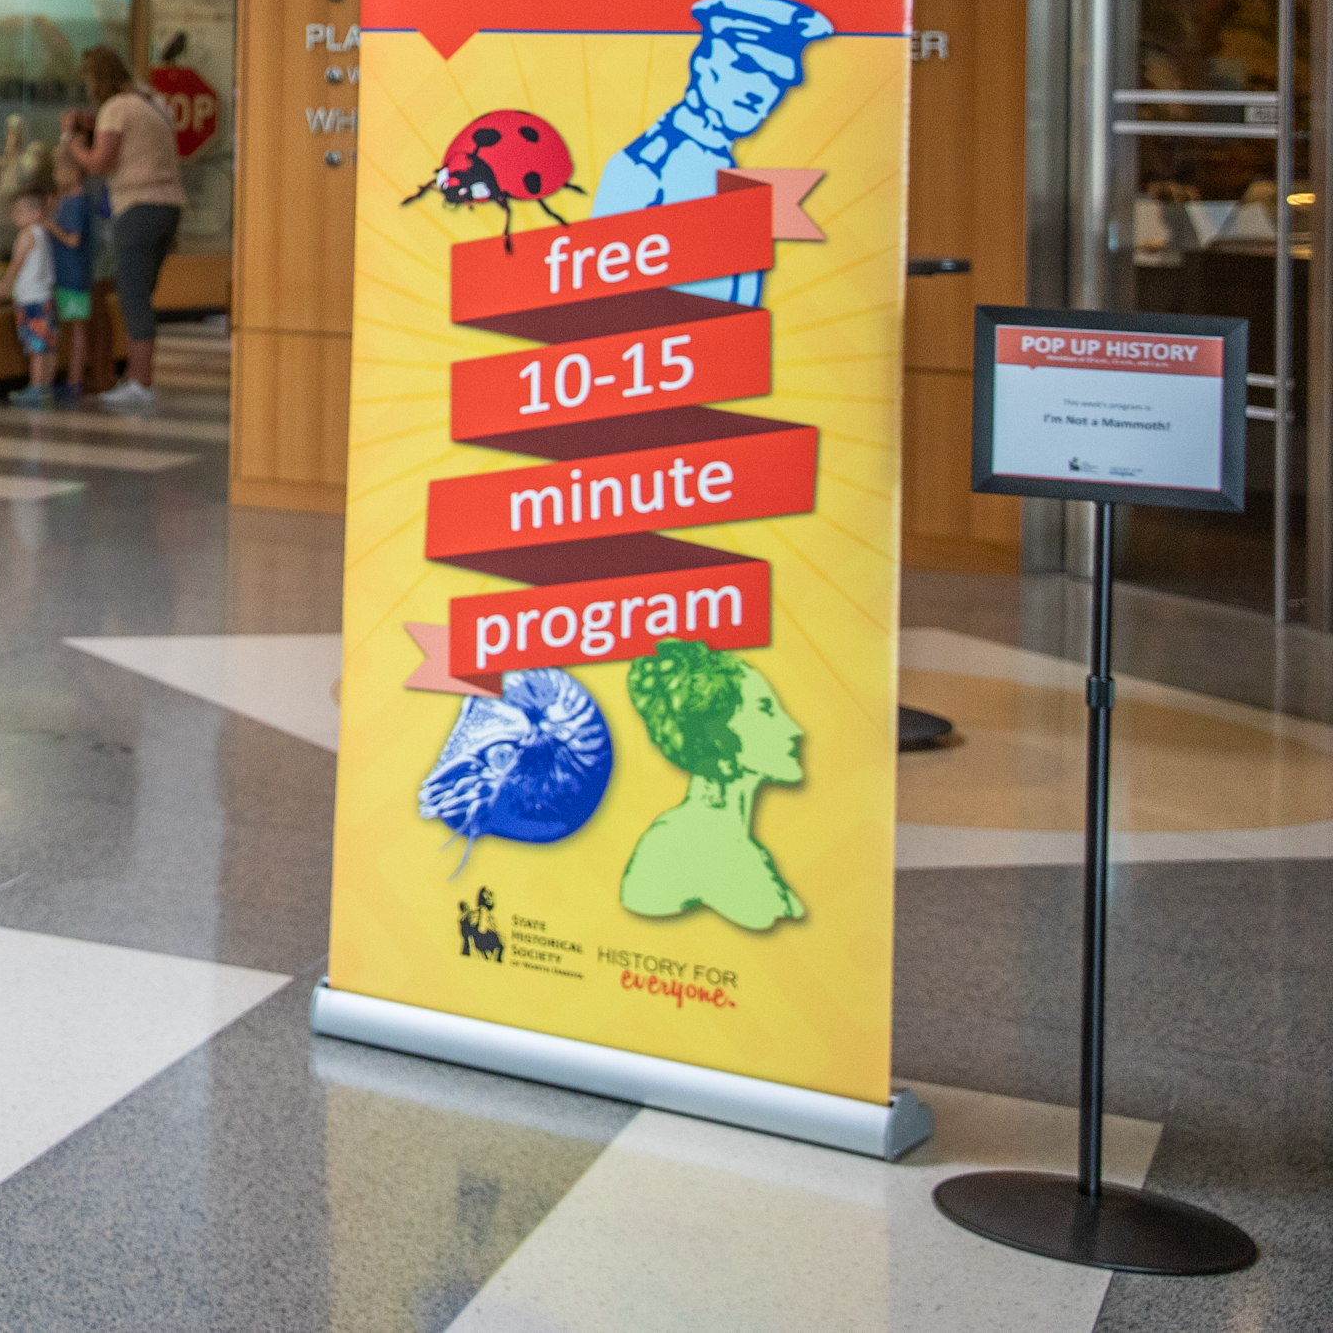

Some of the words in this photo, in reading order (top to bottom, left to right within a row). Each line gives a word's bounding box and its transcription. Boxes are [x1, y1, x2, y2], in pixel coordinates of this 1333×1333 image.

[544, 233, 671, 294] free
[1021, 335, 1066, 354] POP
[1070, 339, 1101, 356] UP
[1106, 340, 1198, 363] HISTORY
[518, 334, 695, 414] 10-15
[1066, 416, 1088, 426] Not
[1101, 418, 1171, 432] Mammoth!
[509, 457, 734, 532] minute
[475, 585, 743, 670] program
[511, 930, 583, 955] HISTORICAL
[511, 944, 561, 964] SOCIETY
[597, 947, 688, 977] HISTORY
[693, 965, 738, 988] FOR
[621, 969, 736, 1008] everyone.
